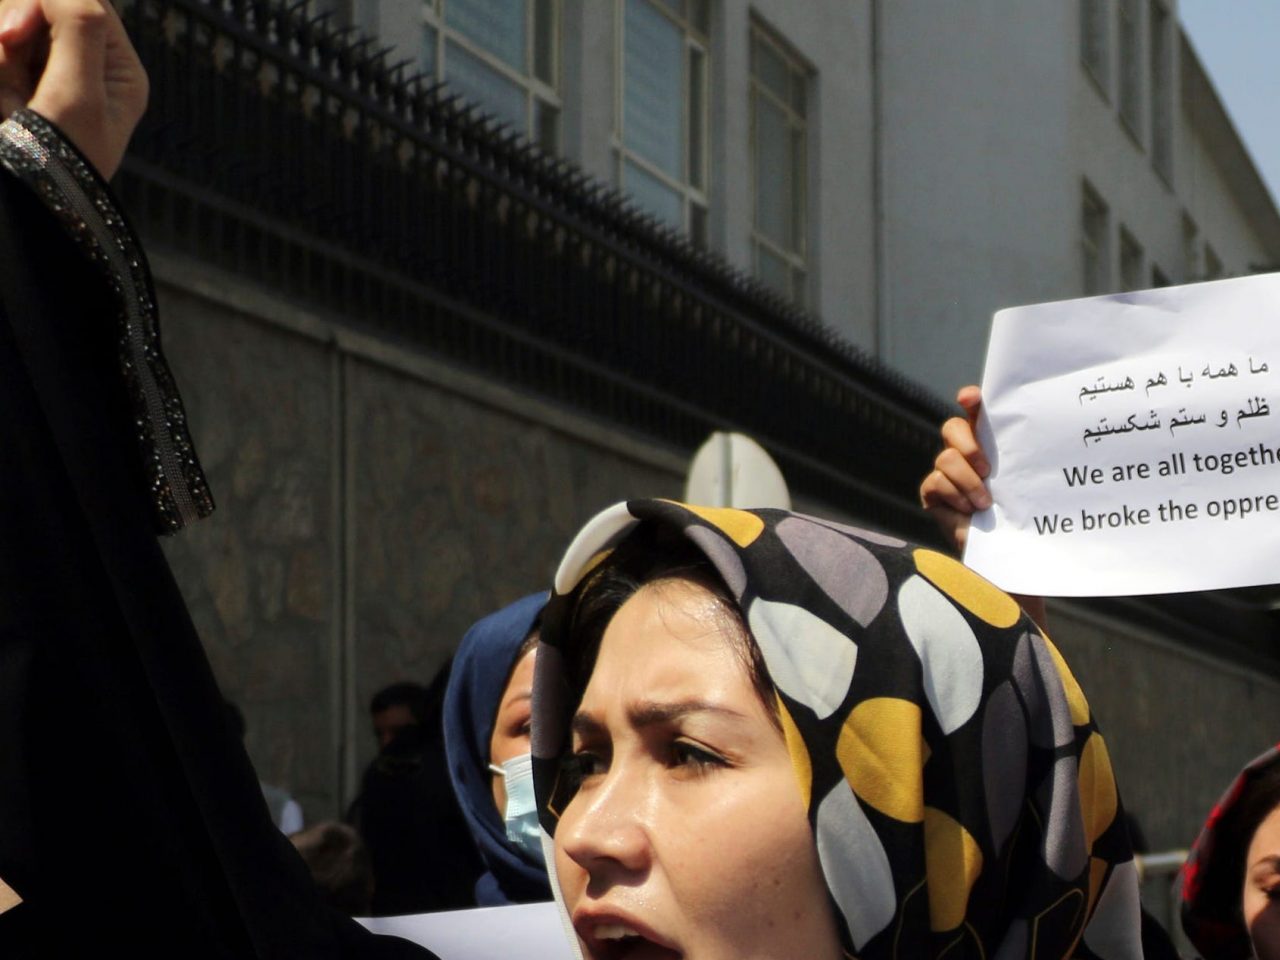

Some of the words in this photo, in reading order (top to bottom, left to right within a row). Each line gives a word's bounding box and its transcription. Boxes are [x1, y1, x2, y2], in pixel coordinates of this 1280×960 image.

[1178, 366, 1194, 389] با
[1201, 362, 1239, 380] همه
[1248, 357, 1269, 375] ما
[1145, 371, 1168, 397] هم
[1169, 407, 1207, 437] ستم
[1215, 409, 1229, 429] و
[1236, 396, 1271, 429] ظلم
[1082, 409, 1162, 447] شکستیم
[1062, 464, 1104, 488] We
[1111, 462, 1151, 483] are
[1157, 452, 1186, 477] all
[1033, 513, 1074, 536] We
[1081, 504, 1151, 531] broke
[1157, 499, 1199, 523] the
